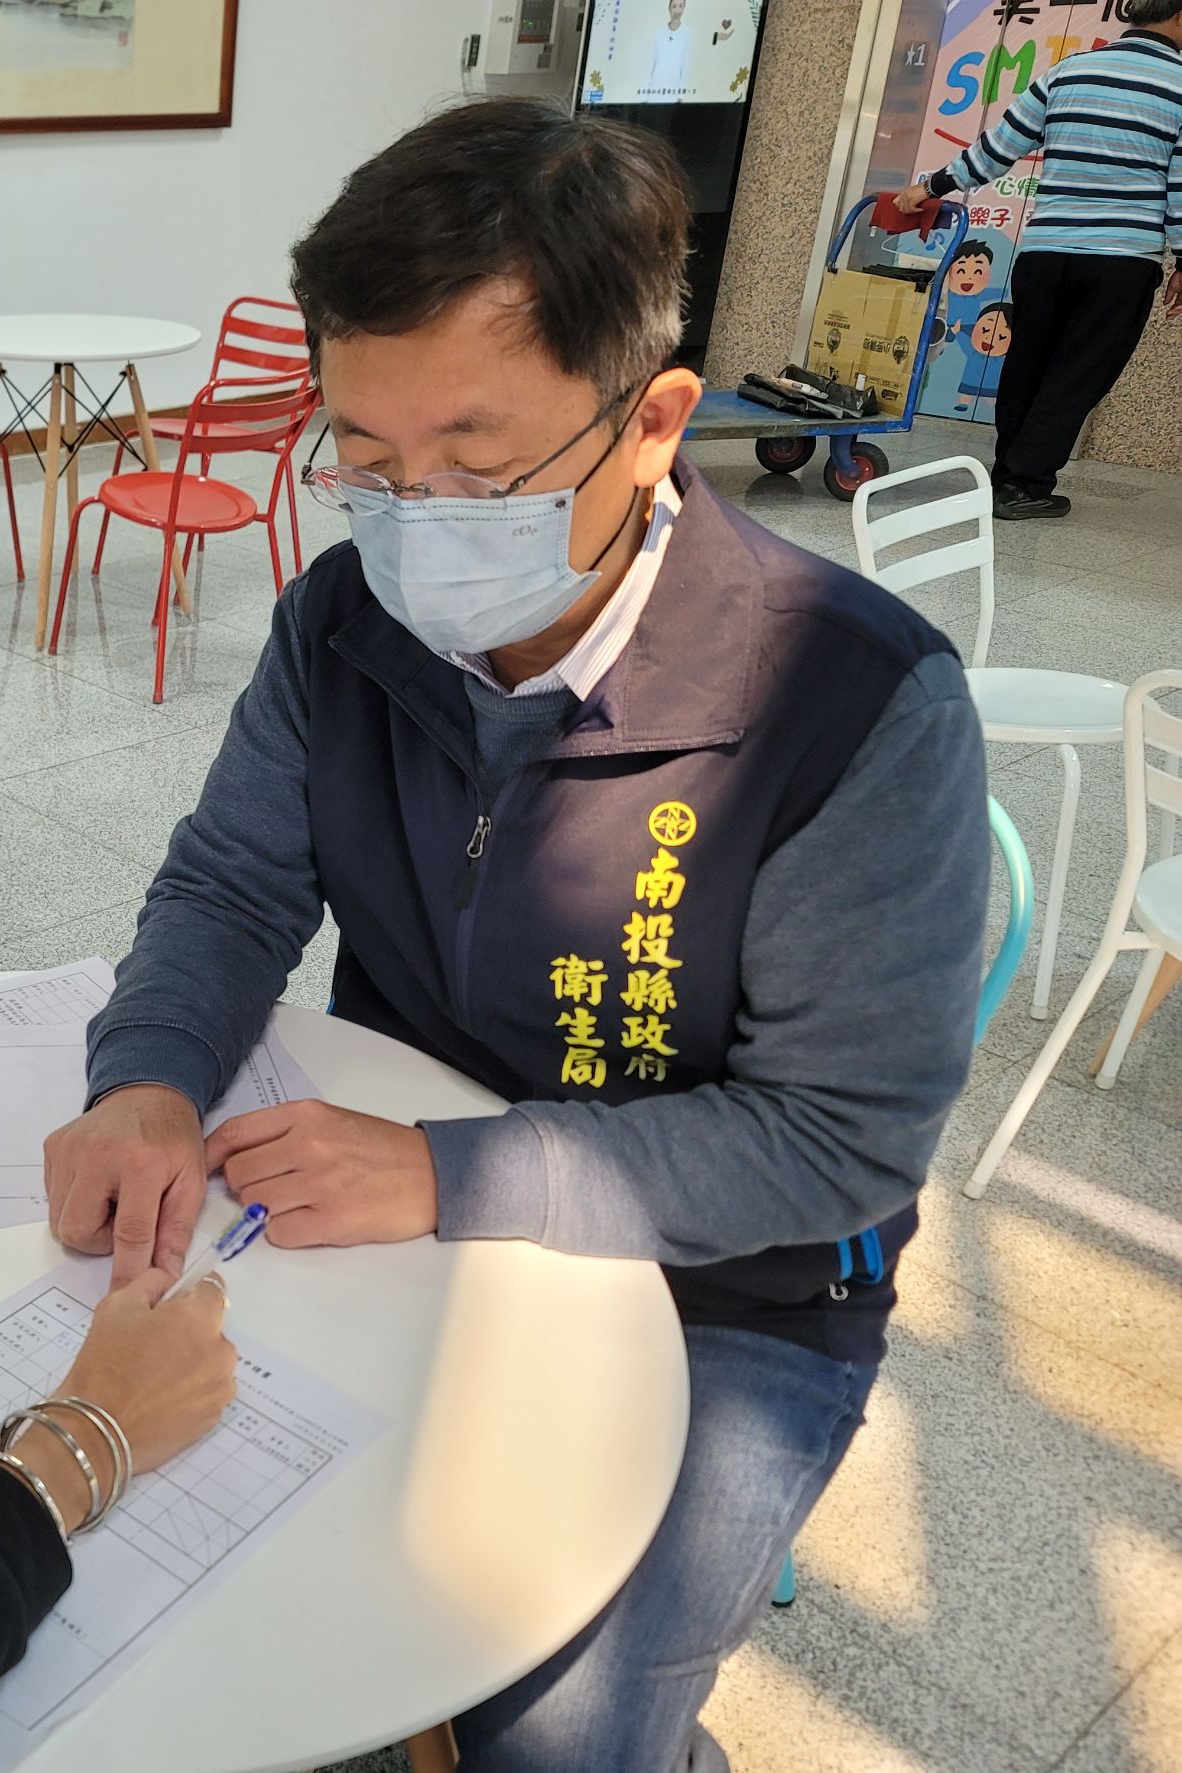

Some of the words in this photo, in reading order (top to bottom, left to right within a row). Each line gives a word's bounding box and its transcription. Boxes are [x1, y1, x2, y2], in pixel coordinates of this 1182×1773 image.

[953, 207, 1011, 228] 樂子
[549, 953, 609, 1088] 衛生局
[620, 848, 687, 1082] 南投縣政府
